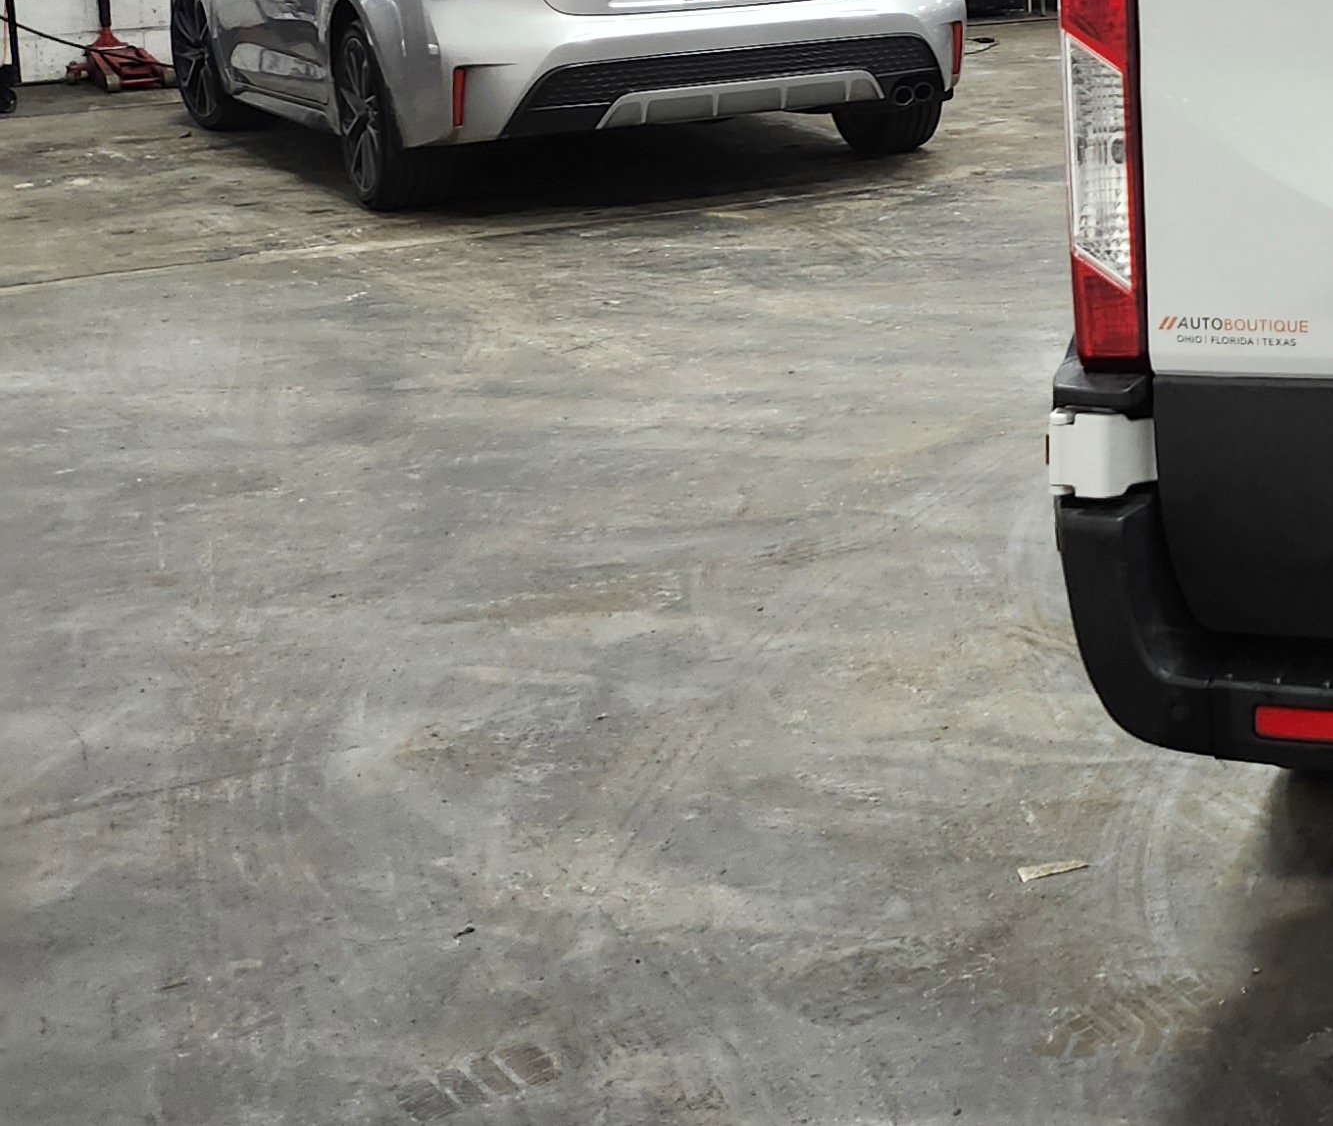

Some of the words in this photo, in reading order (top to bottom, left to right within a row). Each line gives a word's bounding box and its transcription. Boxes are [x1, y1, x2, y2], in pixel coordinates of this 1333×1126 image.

[1177, 316, 1309, 334] AUTOBOUTIQUE
[1177, 335, 1202, 344] OHIO
[1210, 336, 1254, 346] FLORIDA
[1263, 338, 1297, 347] TEXAS
